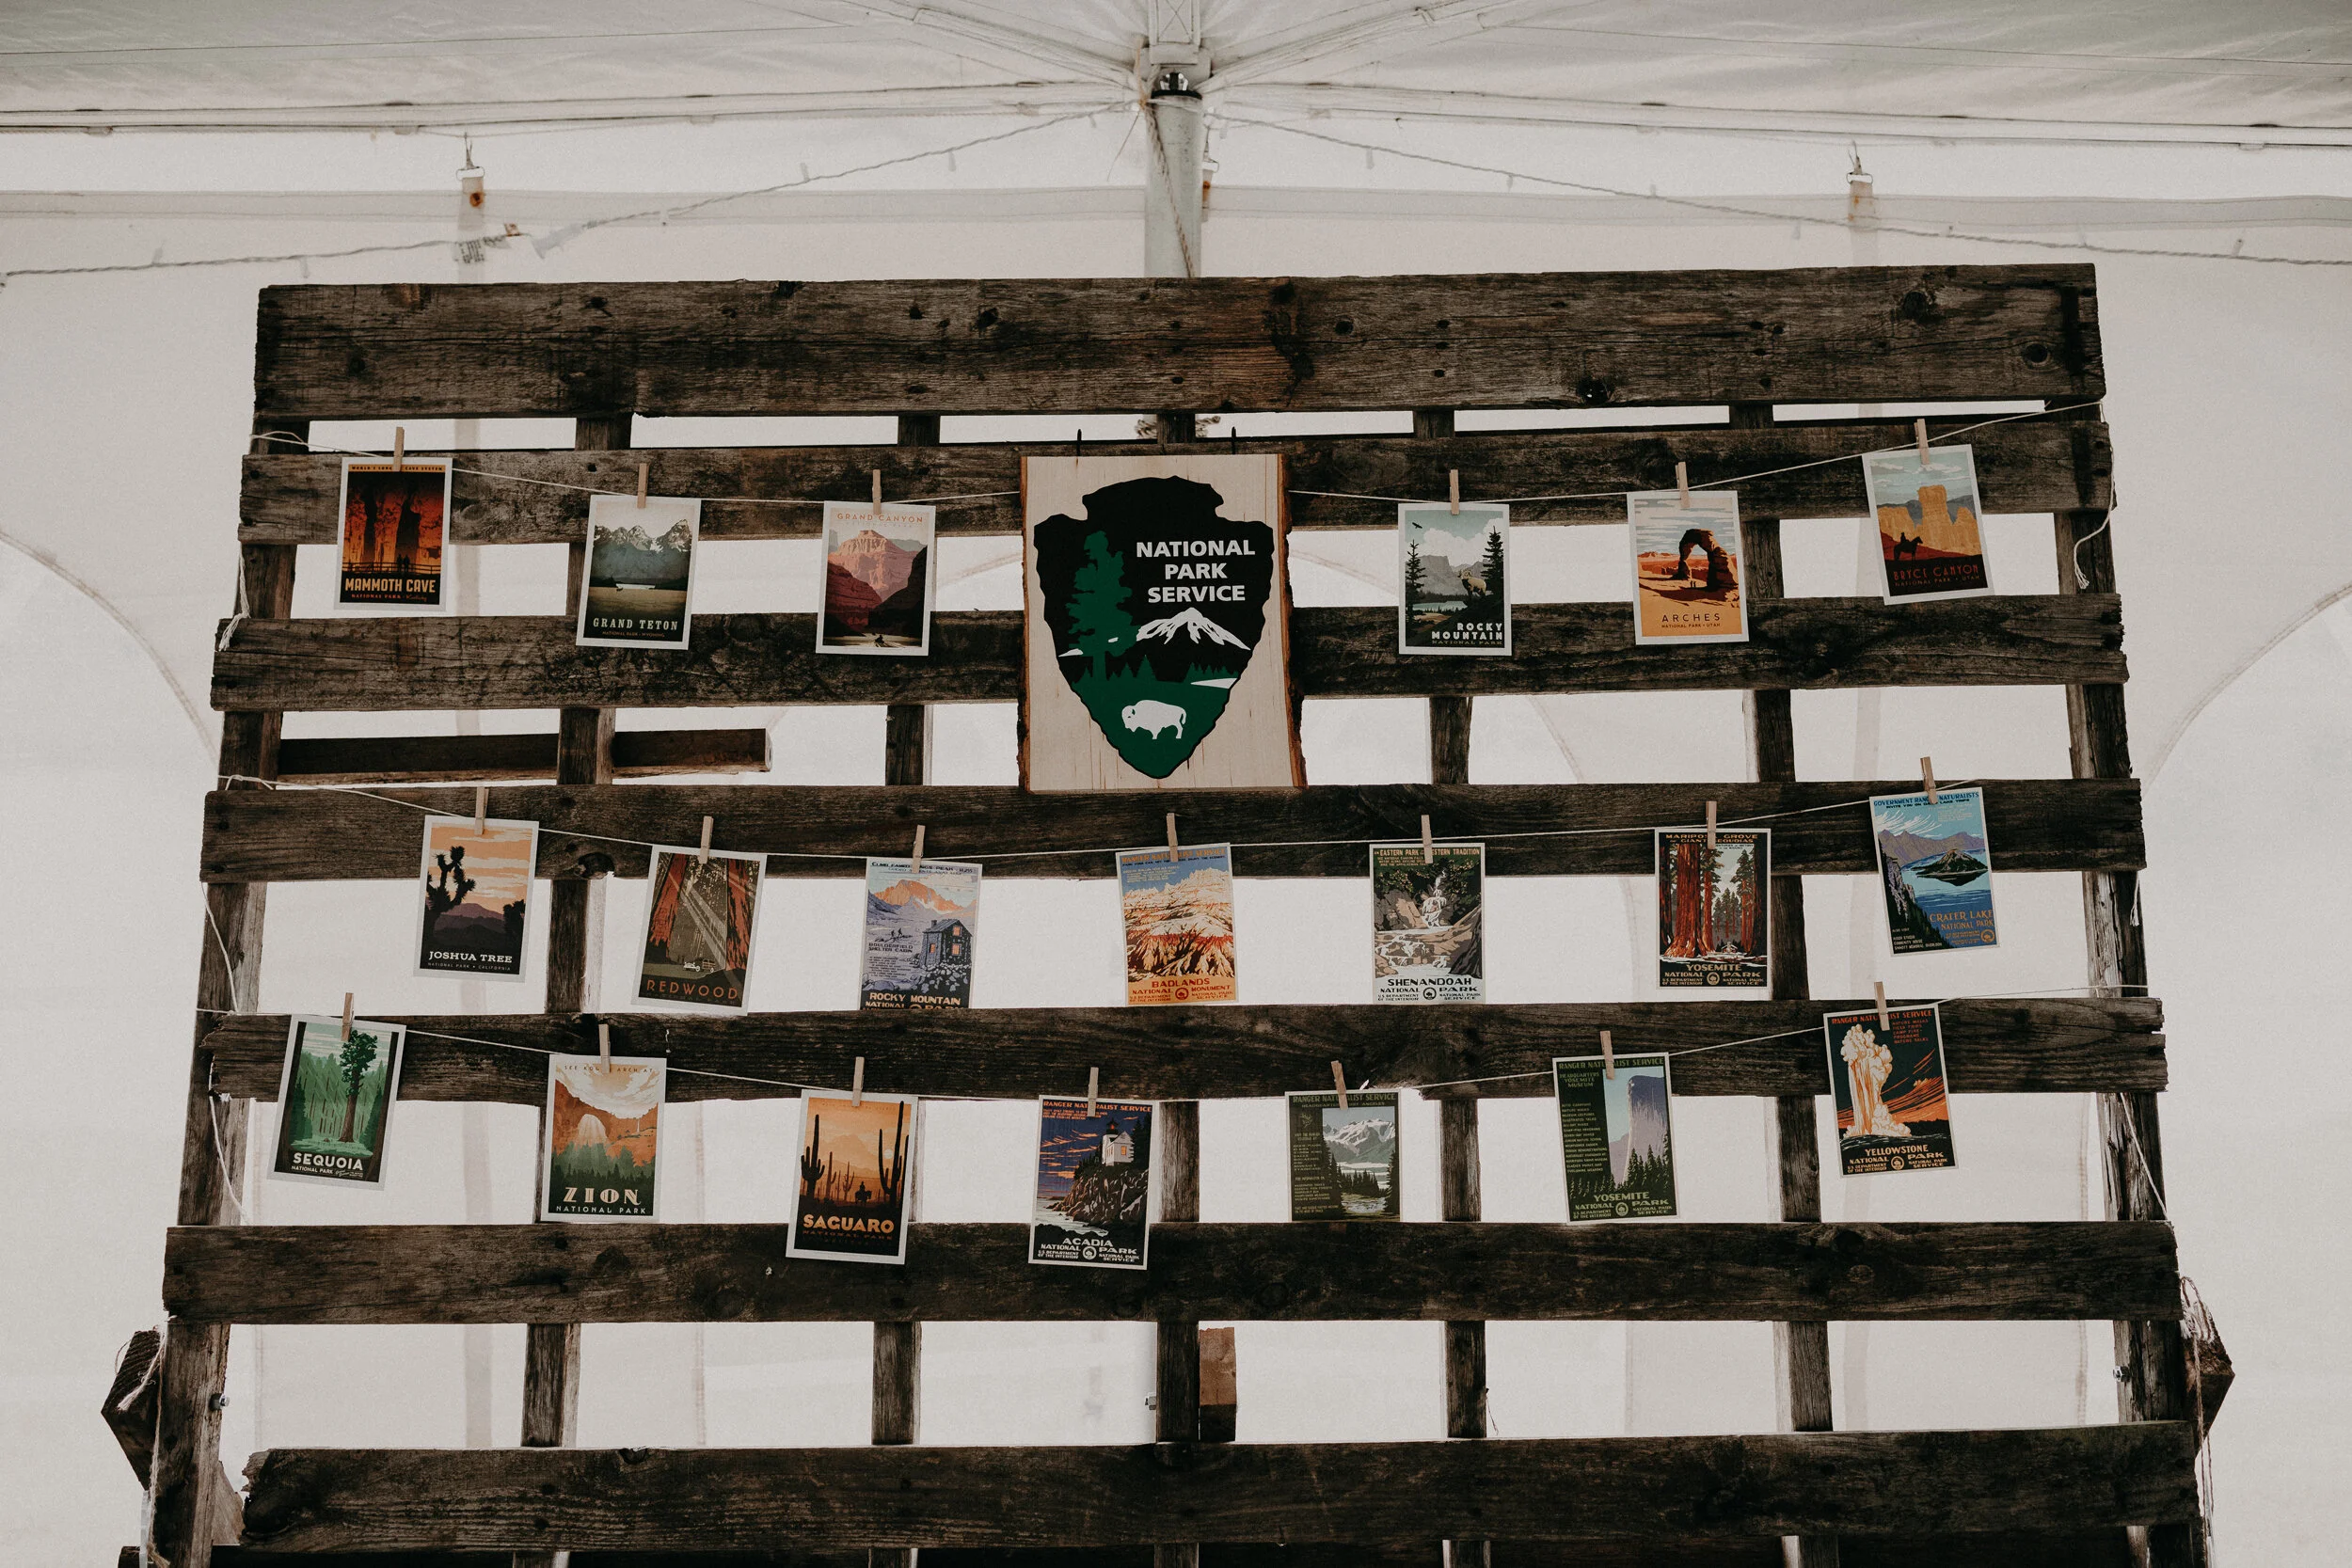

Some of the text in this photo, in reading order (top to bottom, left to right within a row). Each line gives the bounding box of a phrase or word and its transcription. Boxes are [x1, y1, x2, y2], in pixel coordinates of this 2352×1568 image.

[837, 513, 923, 523] GRAND CANYON
[1136, 540, 1255, 558] NATIONAL
[1165, 562, 1228, 579] PARK
[1894, 564, 1978, 580] BRYCE CANYON
[345, 578, 436, 593] MAMMOTH CAVE
[1148, 585, 1246, 603] SERVICE
[593, 617, 677, 630] GRAND TETON
[1661, 613, 1721, 623] ARCHES
[1457, 623, 1502, 631] ROCKY
[1431, 631, 1502, 641] MOUNTAIN
[1874, 798, 1914, 806] GOVERNMENT
[1939, 792, 1979, 800] NATURALISTS
[1930, 910, 1994, 922] CRATER LAKE
[1941, 922, 1974, 930] NATIONAL
[429, 951, 512, 963] JOSHUA TREE
[647, 979, 738, 999] REDWOOD
[1152, 978, 1210, 988] BADLANDS
[869, 992, 961, 1005] ROCKY MOUNTAIN
[1865, 1145, 1929, 1156] YELLOWSTONE
[294, 1152, 363, 1170] SEQUOIA
[564, 1186, 642, 1206] ZION
[1594, 1192, 1649, 1202] YOSEMITE
[556, 1205, 612, 1213] NATIONAL
[803, 1213, 894, 1234] SAGUARO
[1062, 1238, 1114, 1247] ACADIA
